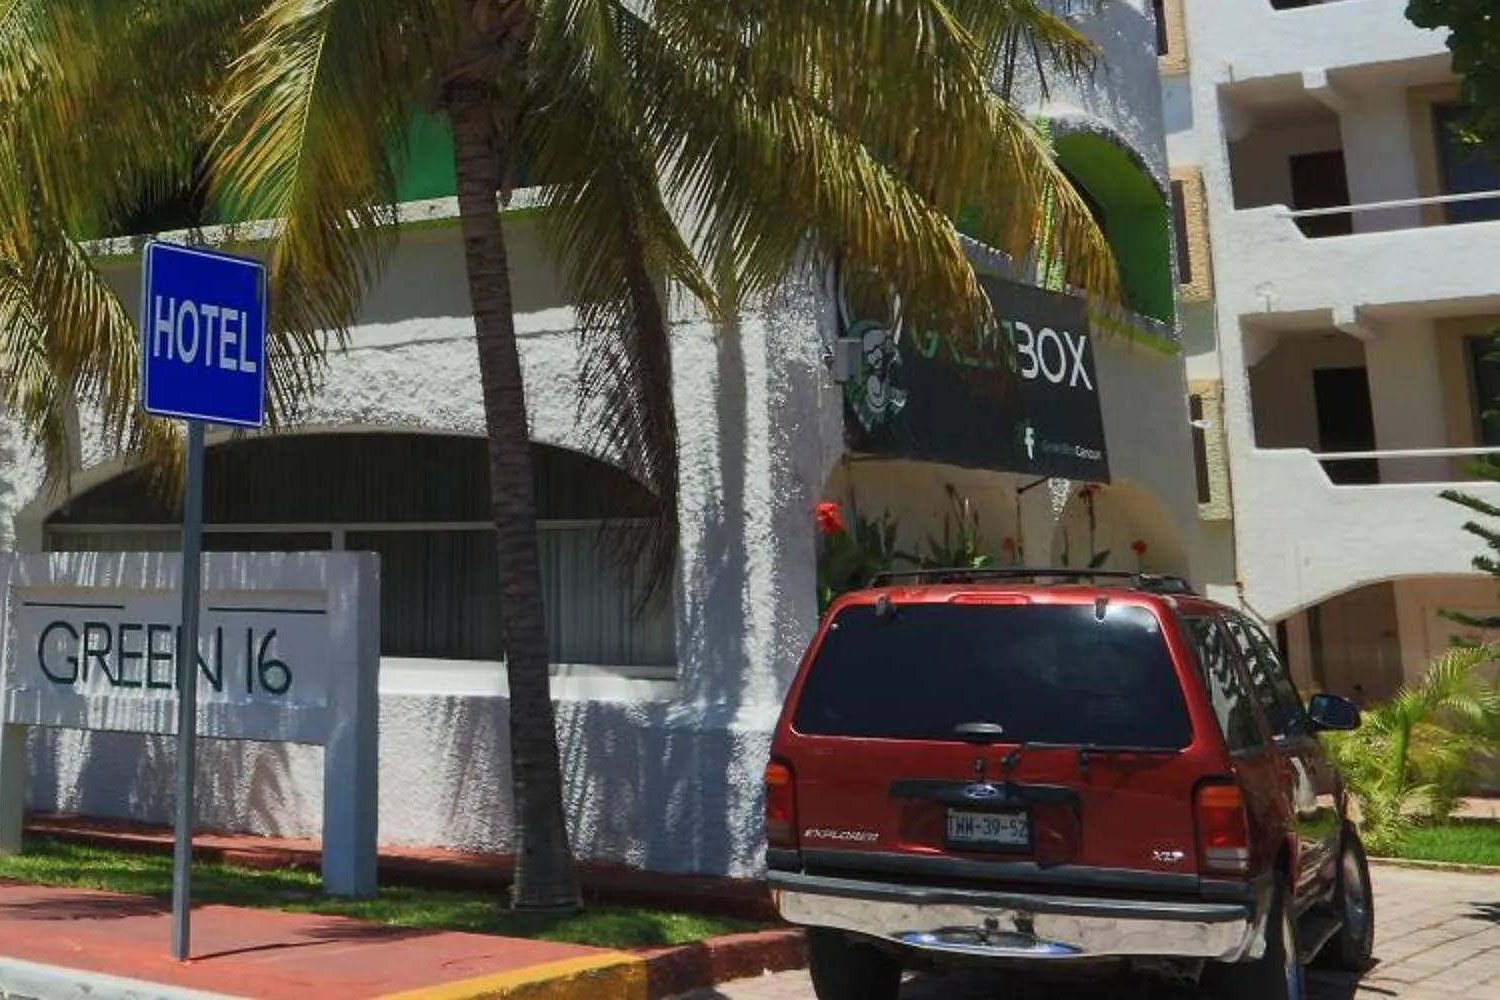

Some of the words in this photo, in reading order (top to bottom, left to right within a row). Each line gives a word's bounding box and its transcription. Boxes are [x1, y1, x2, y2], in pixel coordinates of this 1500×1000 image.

[153, 295, 257, 373] HOTEL
[38, 620, 223, 693] GREEN
[247, 626, 293, 695] 16
